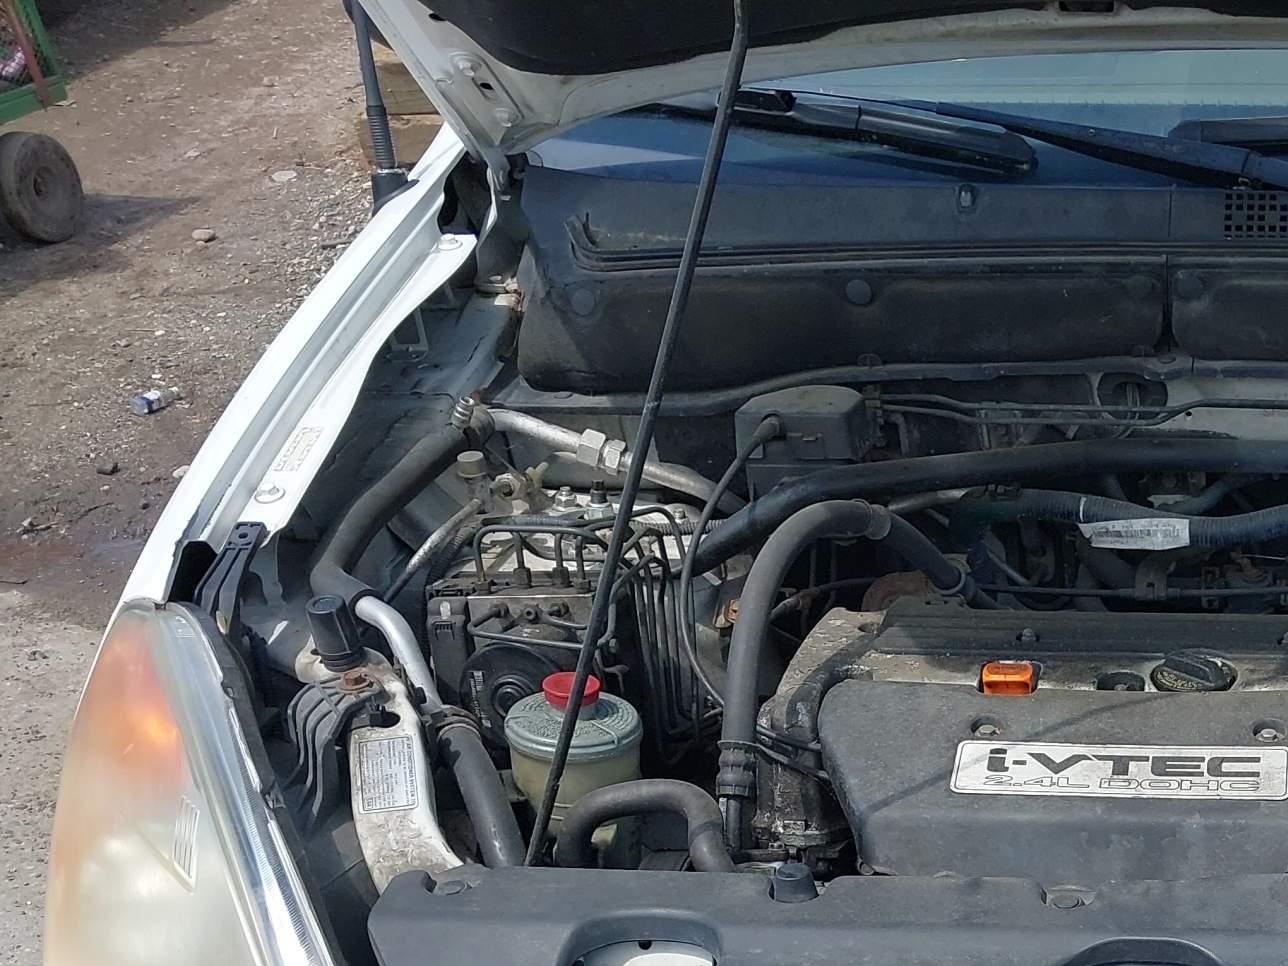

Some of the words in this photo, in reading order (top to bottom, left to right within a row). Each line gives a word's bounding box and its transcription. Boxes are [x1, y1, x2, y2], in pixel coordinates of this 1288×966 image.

[986, 747, 1261, 778] i-VTEC
[983, 775, 1090, 789] 2.4L
[1099, 777, 1261, 792] DOHC
